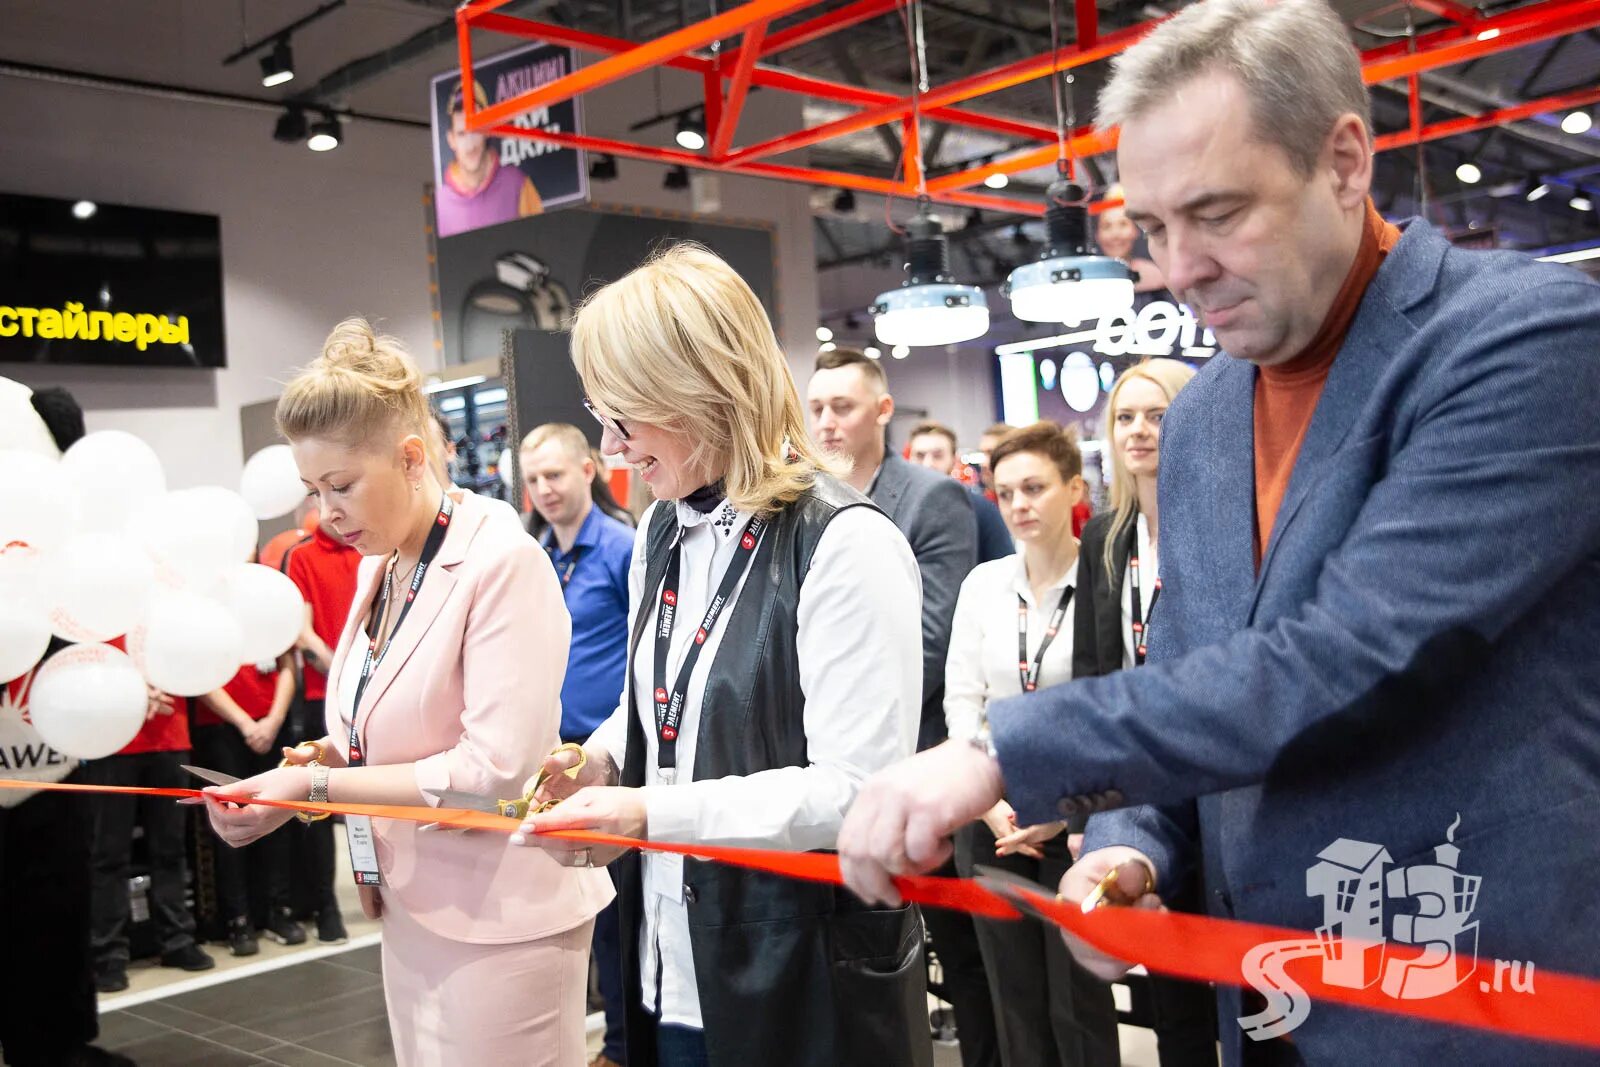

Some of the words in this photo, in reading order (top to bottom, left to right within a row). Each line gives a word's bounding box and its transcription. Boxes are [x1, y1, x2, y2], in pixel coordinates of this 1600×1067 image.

[661, 605, 674, 638] ЭЛЕМЕНТ
[704, 595, 723, 631] ЭЛЕМЕНТ
[666, 691, 682, 727] ЭЛЕМЕНТ
